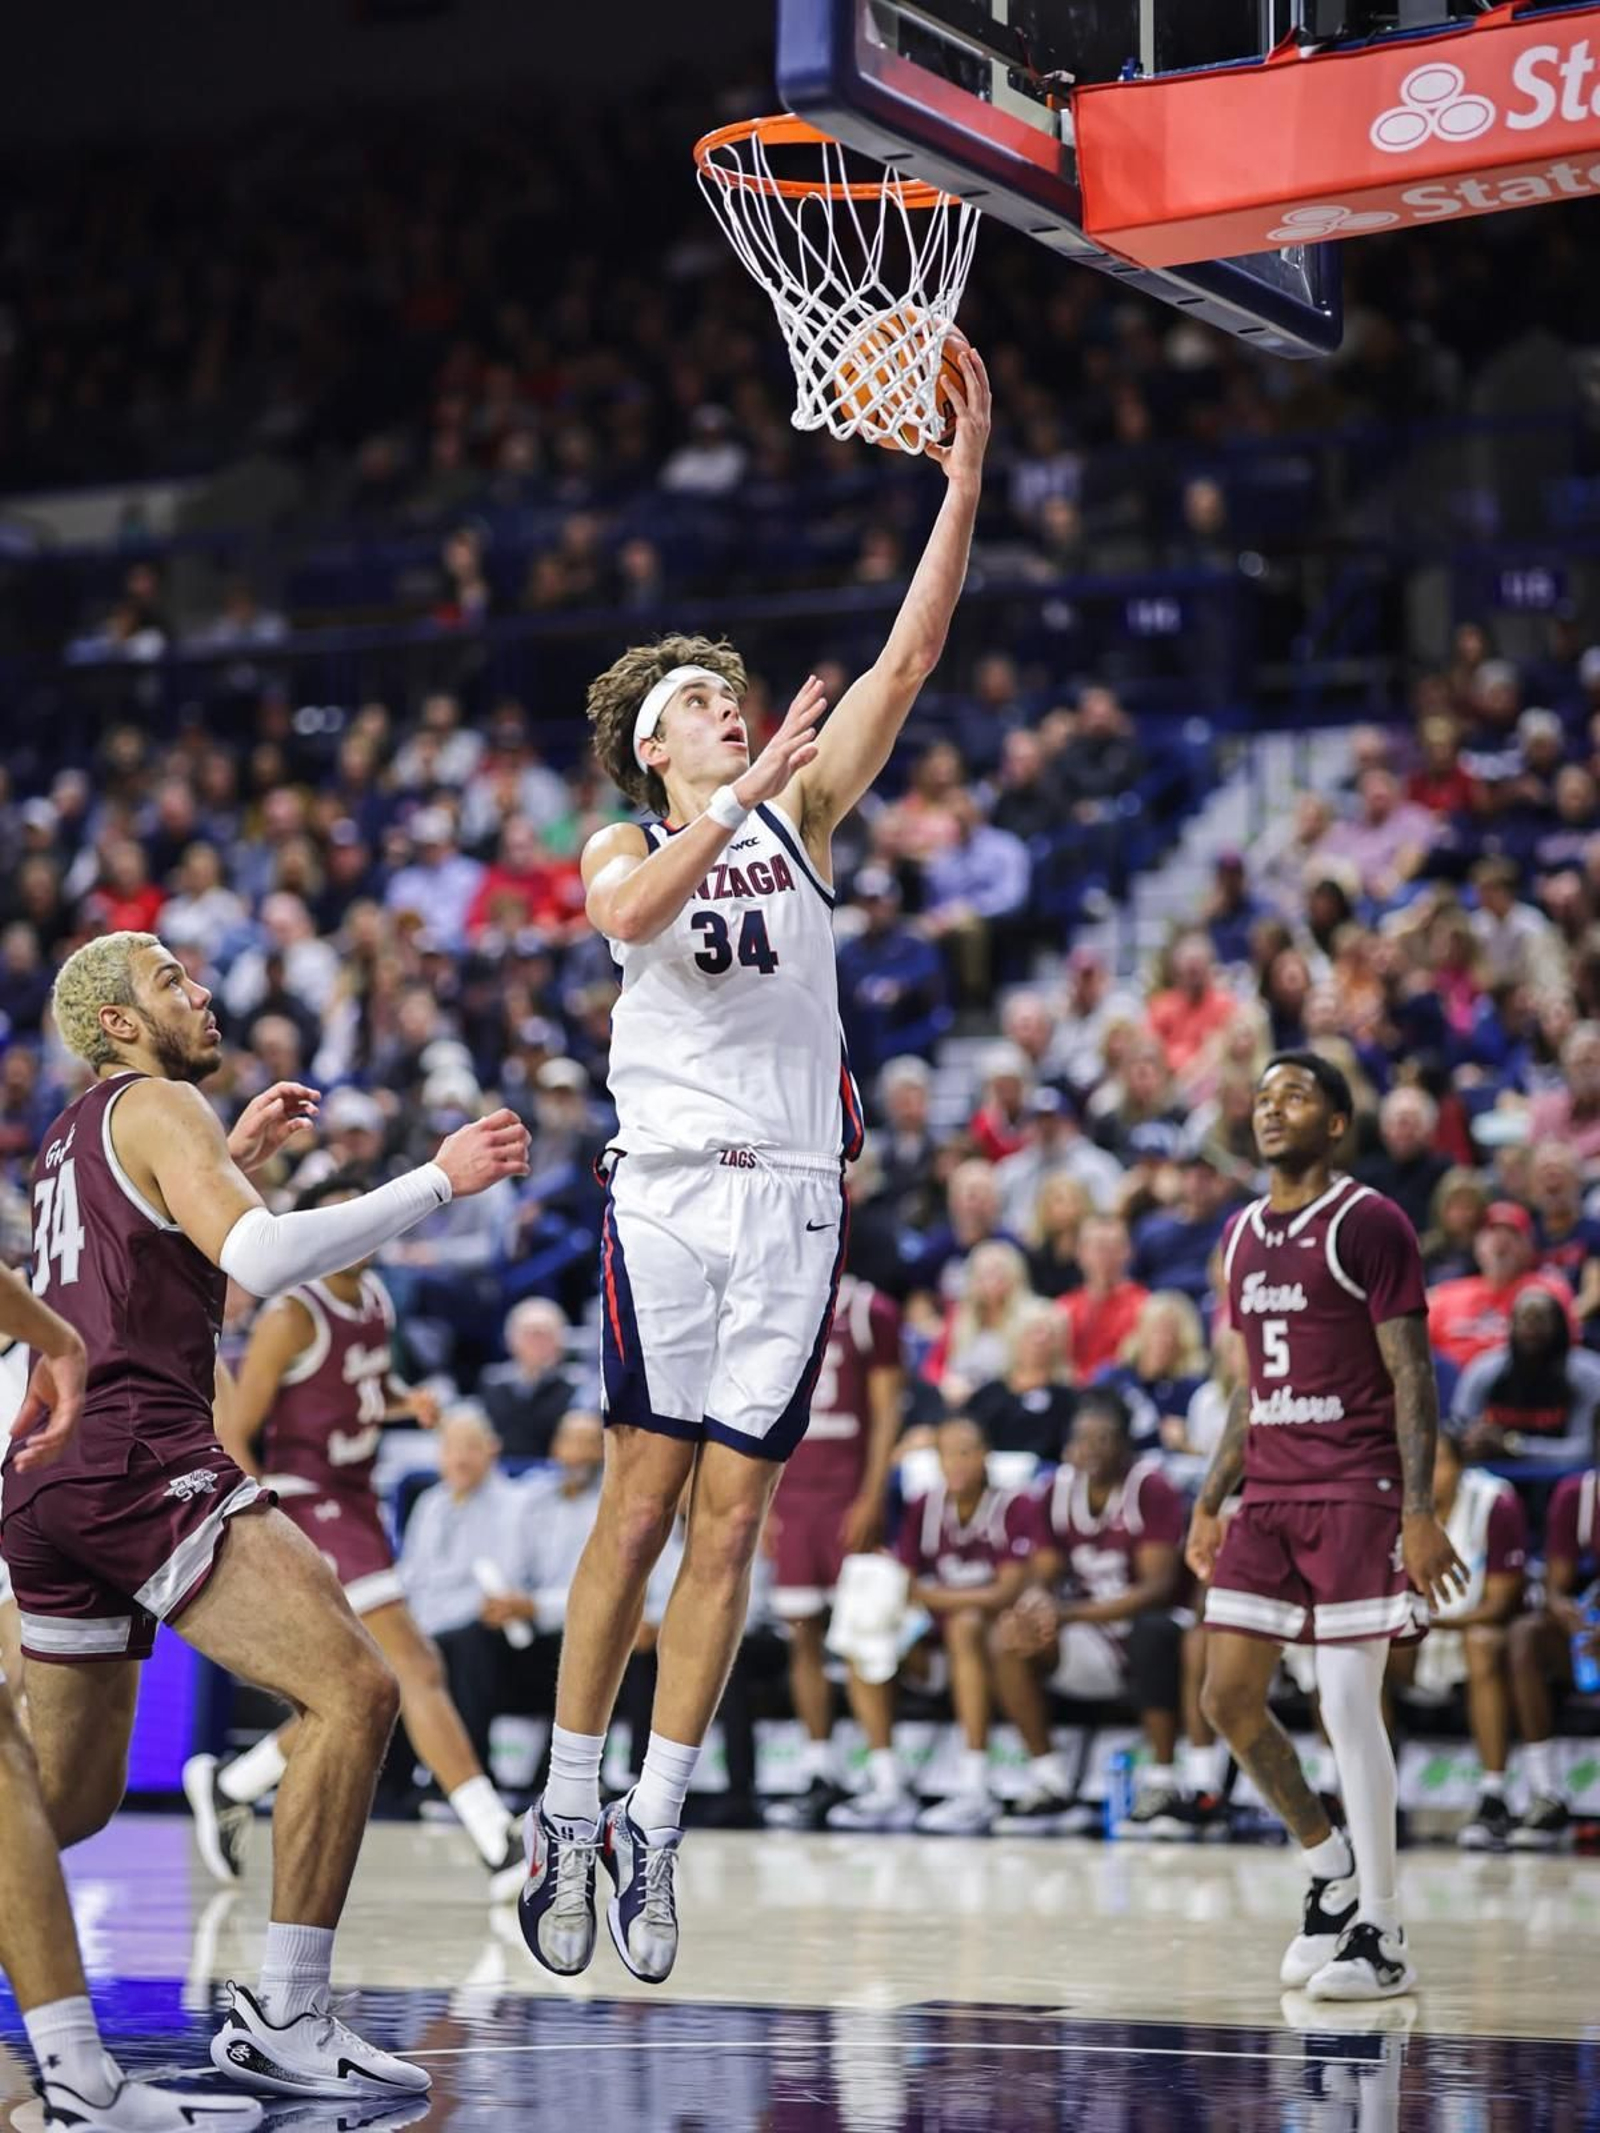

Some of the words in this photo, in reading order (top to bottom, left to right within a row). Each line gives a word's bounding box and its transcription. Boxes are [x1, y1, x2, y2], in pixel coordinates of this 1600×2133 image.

[1505, 39, 1600, 130] St
[691, 910, 779, 975] 34
[720, 1149, 757, 1169] ZAGS
[1263, 1320, 1290, 1378] 5
